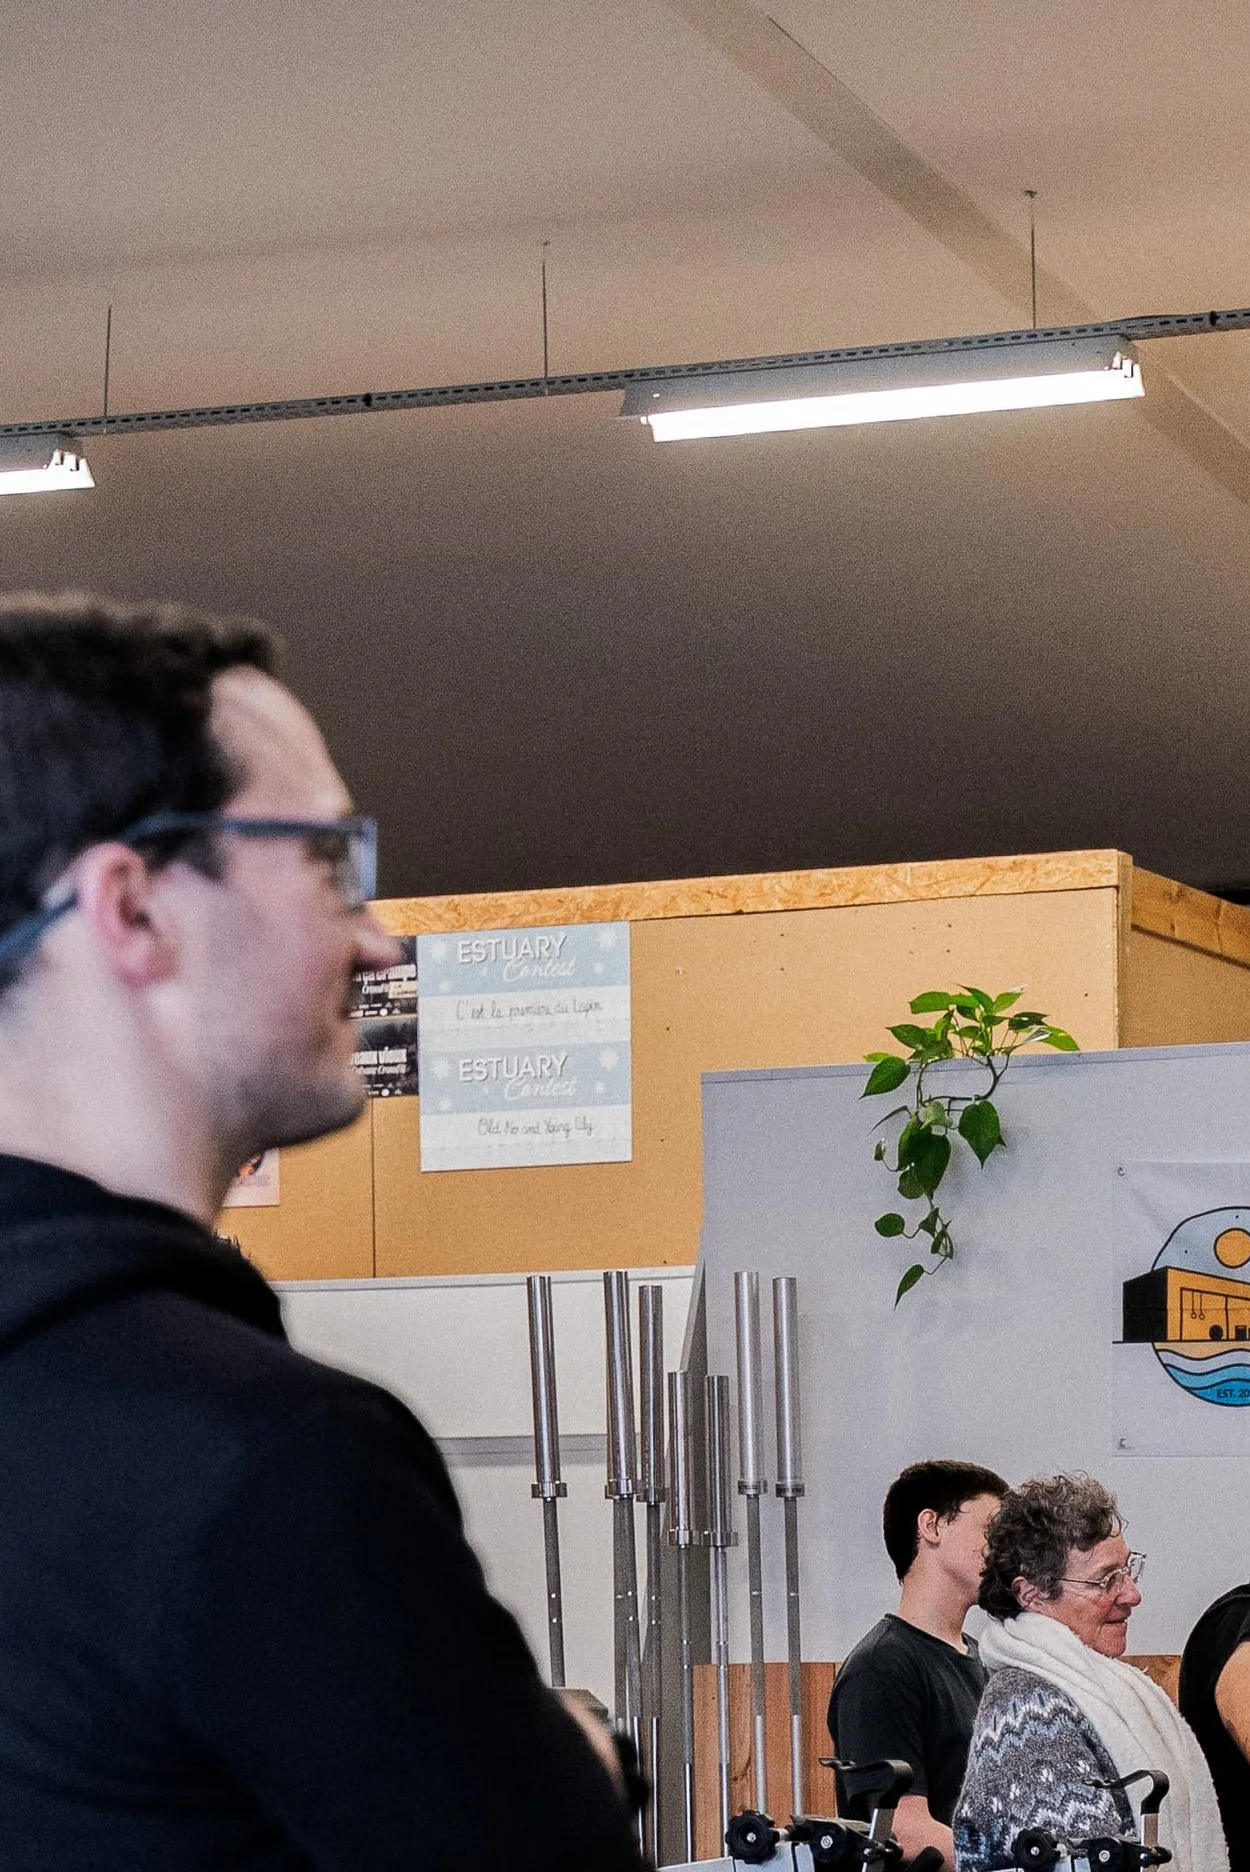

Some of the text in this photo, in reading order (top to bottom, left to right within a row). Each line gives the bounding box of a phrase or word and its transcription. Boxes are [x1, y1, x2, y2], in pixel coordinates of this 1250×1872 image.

[458, 934, 568, 964] ESTUARY
[502, 956, 578, 982] Contest
[459, 1053, 569, 1082] ESTUARY
[504, 1076, 578, 1101] Contest
